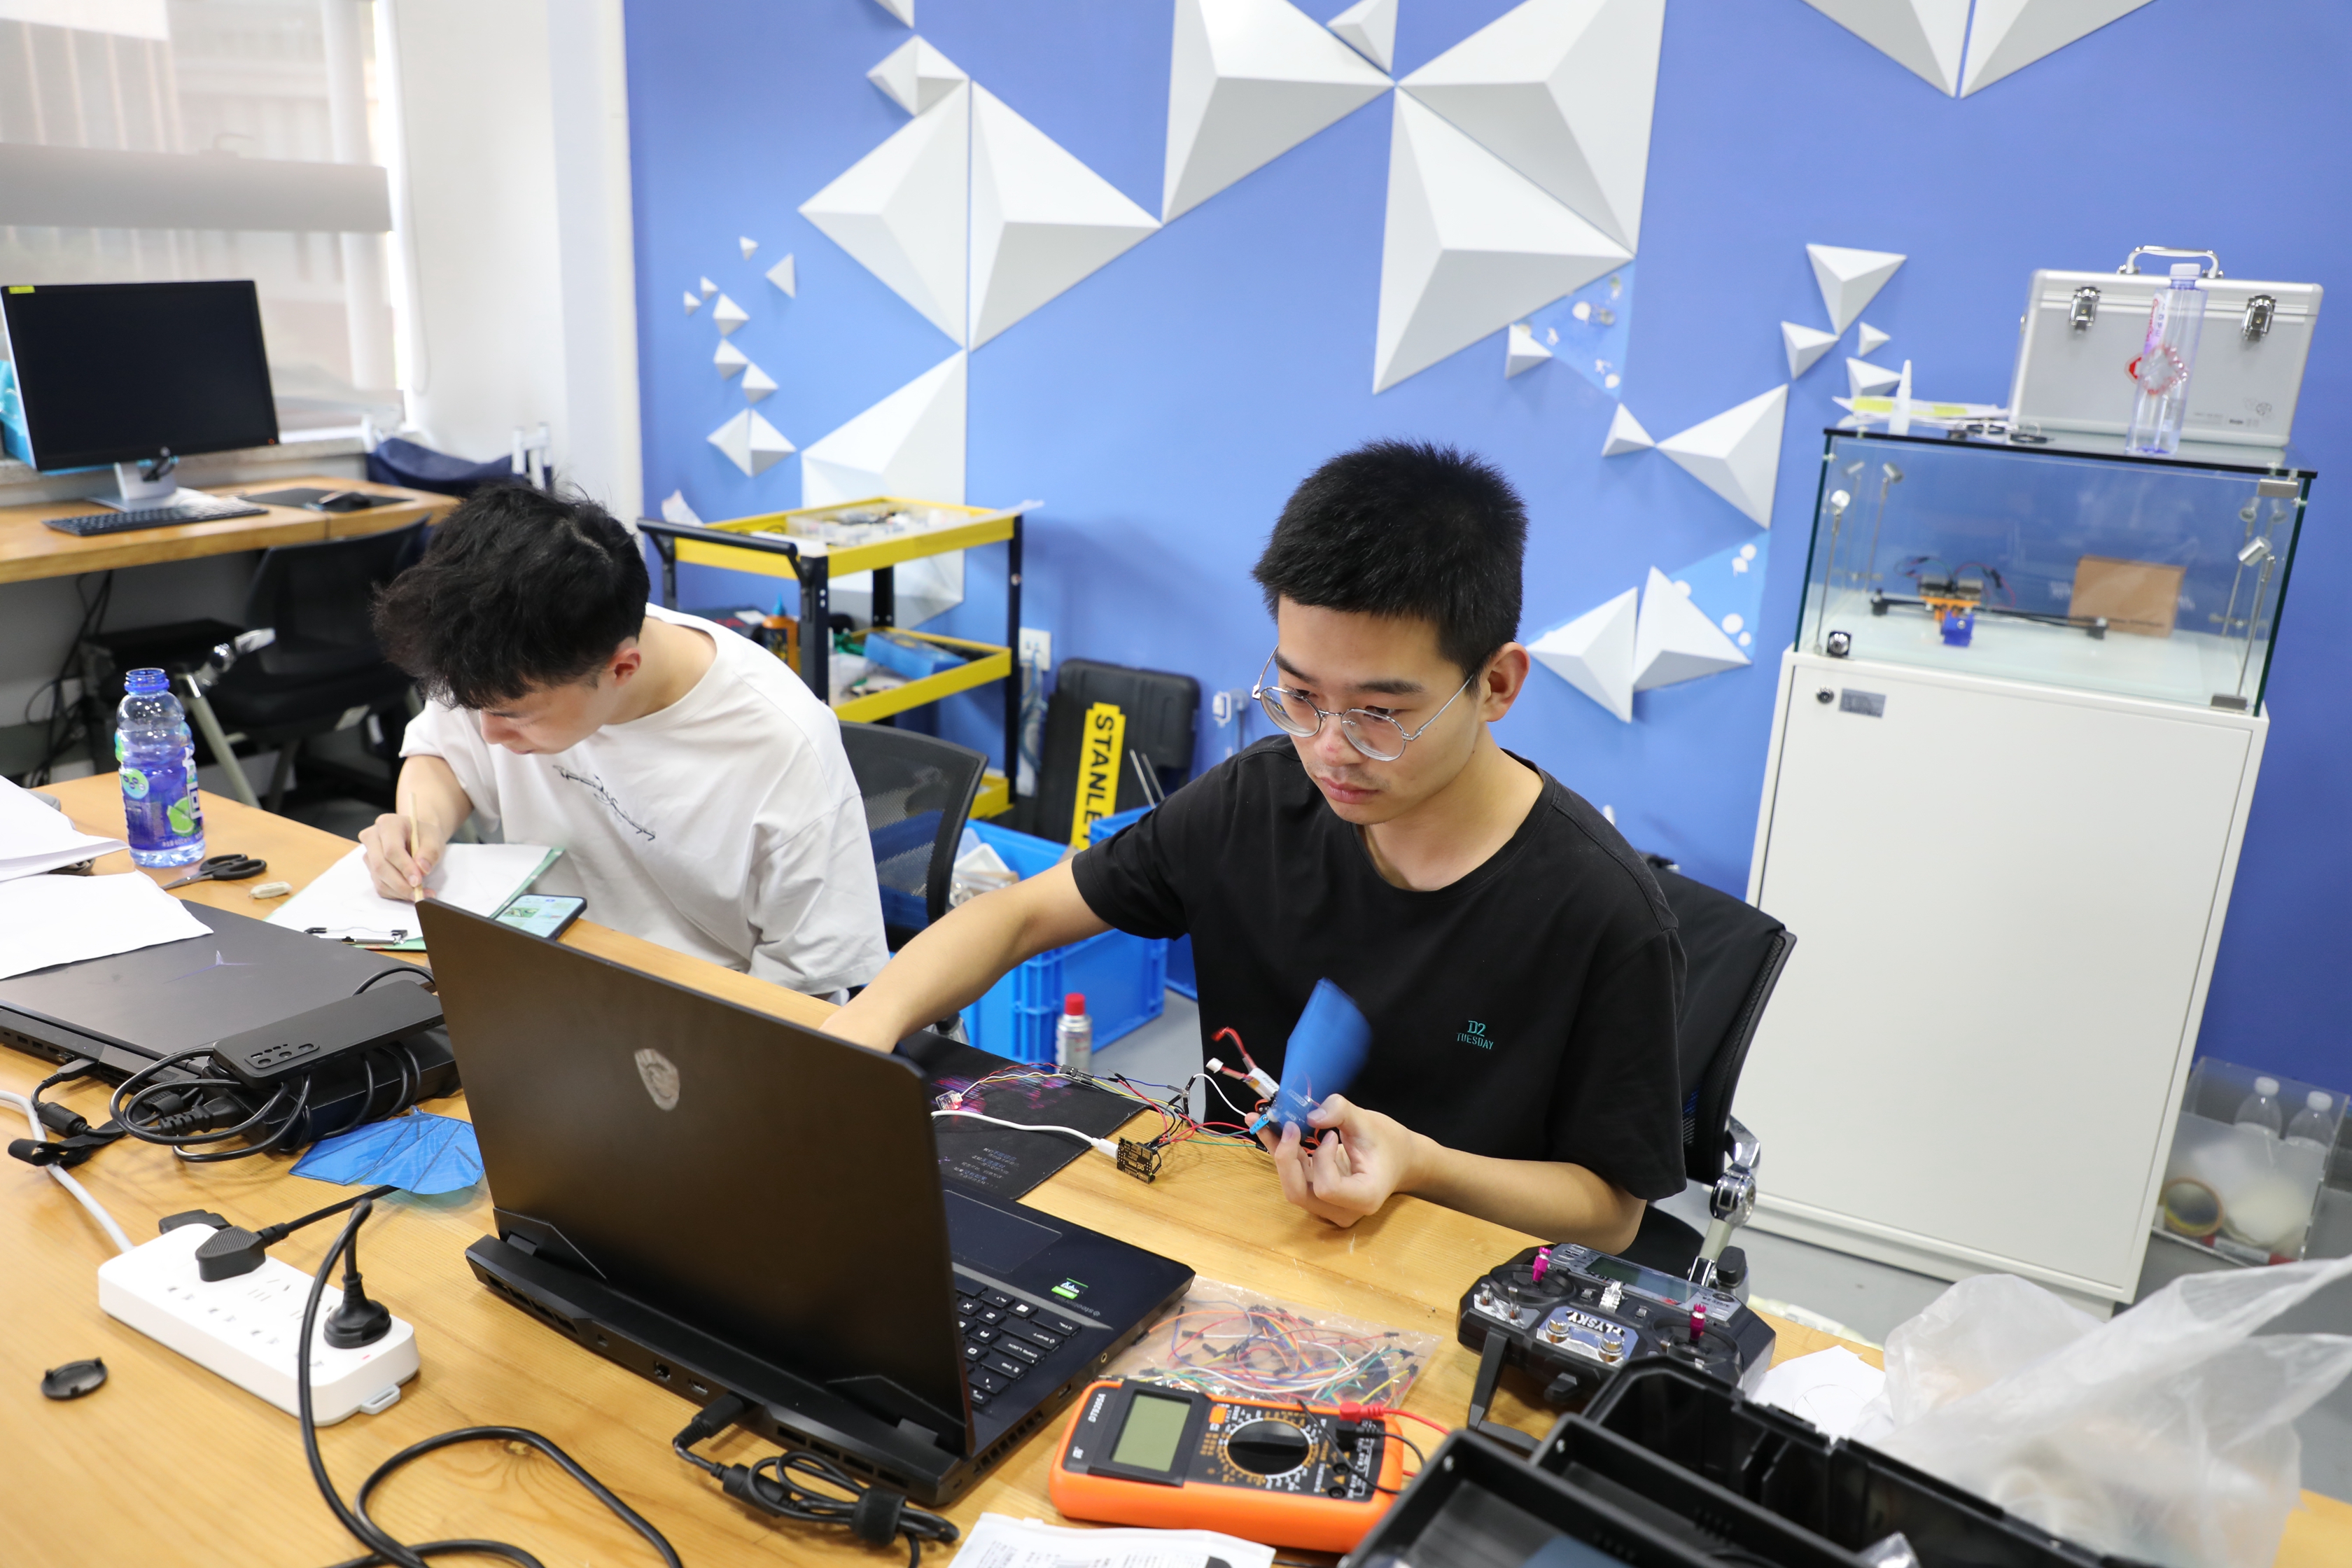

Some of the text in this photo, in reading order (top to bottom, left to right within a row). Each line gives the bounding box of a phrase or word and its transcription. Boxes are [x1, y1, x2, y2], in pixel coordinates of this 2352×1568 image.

[1083, 714, 1114, 839] STANLE
[1467, 1020, 1486, 1037] D2
[1457, 1032, 1494, 1050] TUESDAY
[1567, 1311, 1623, 1335] FLYSKY
[1008, 1343, 1037, 1358] CAPS LOCK
[1088, 1394, 1106, 1422] DT9205A
